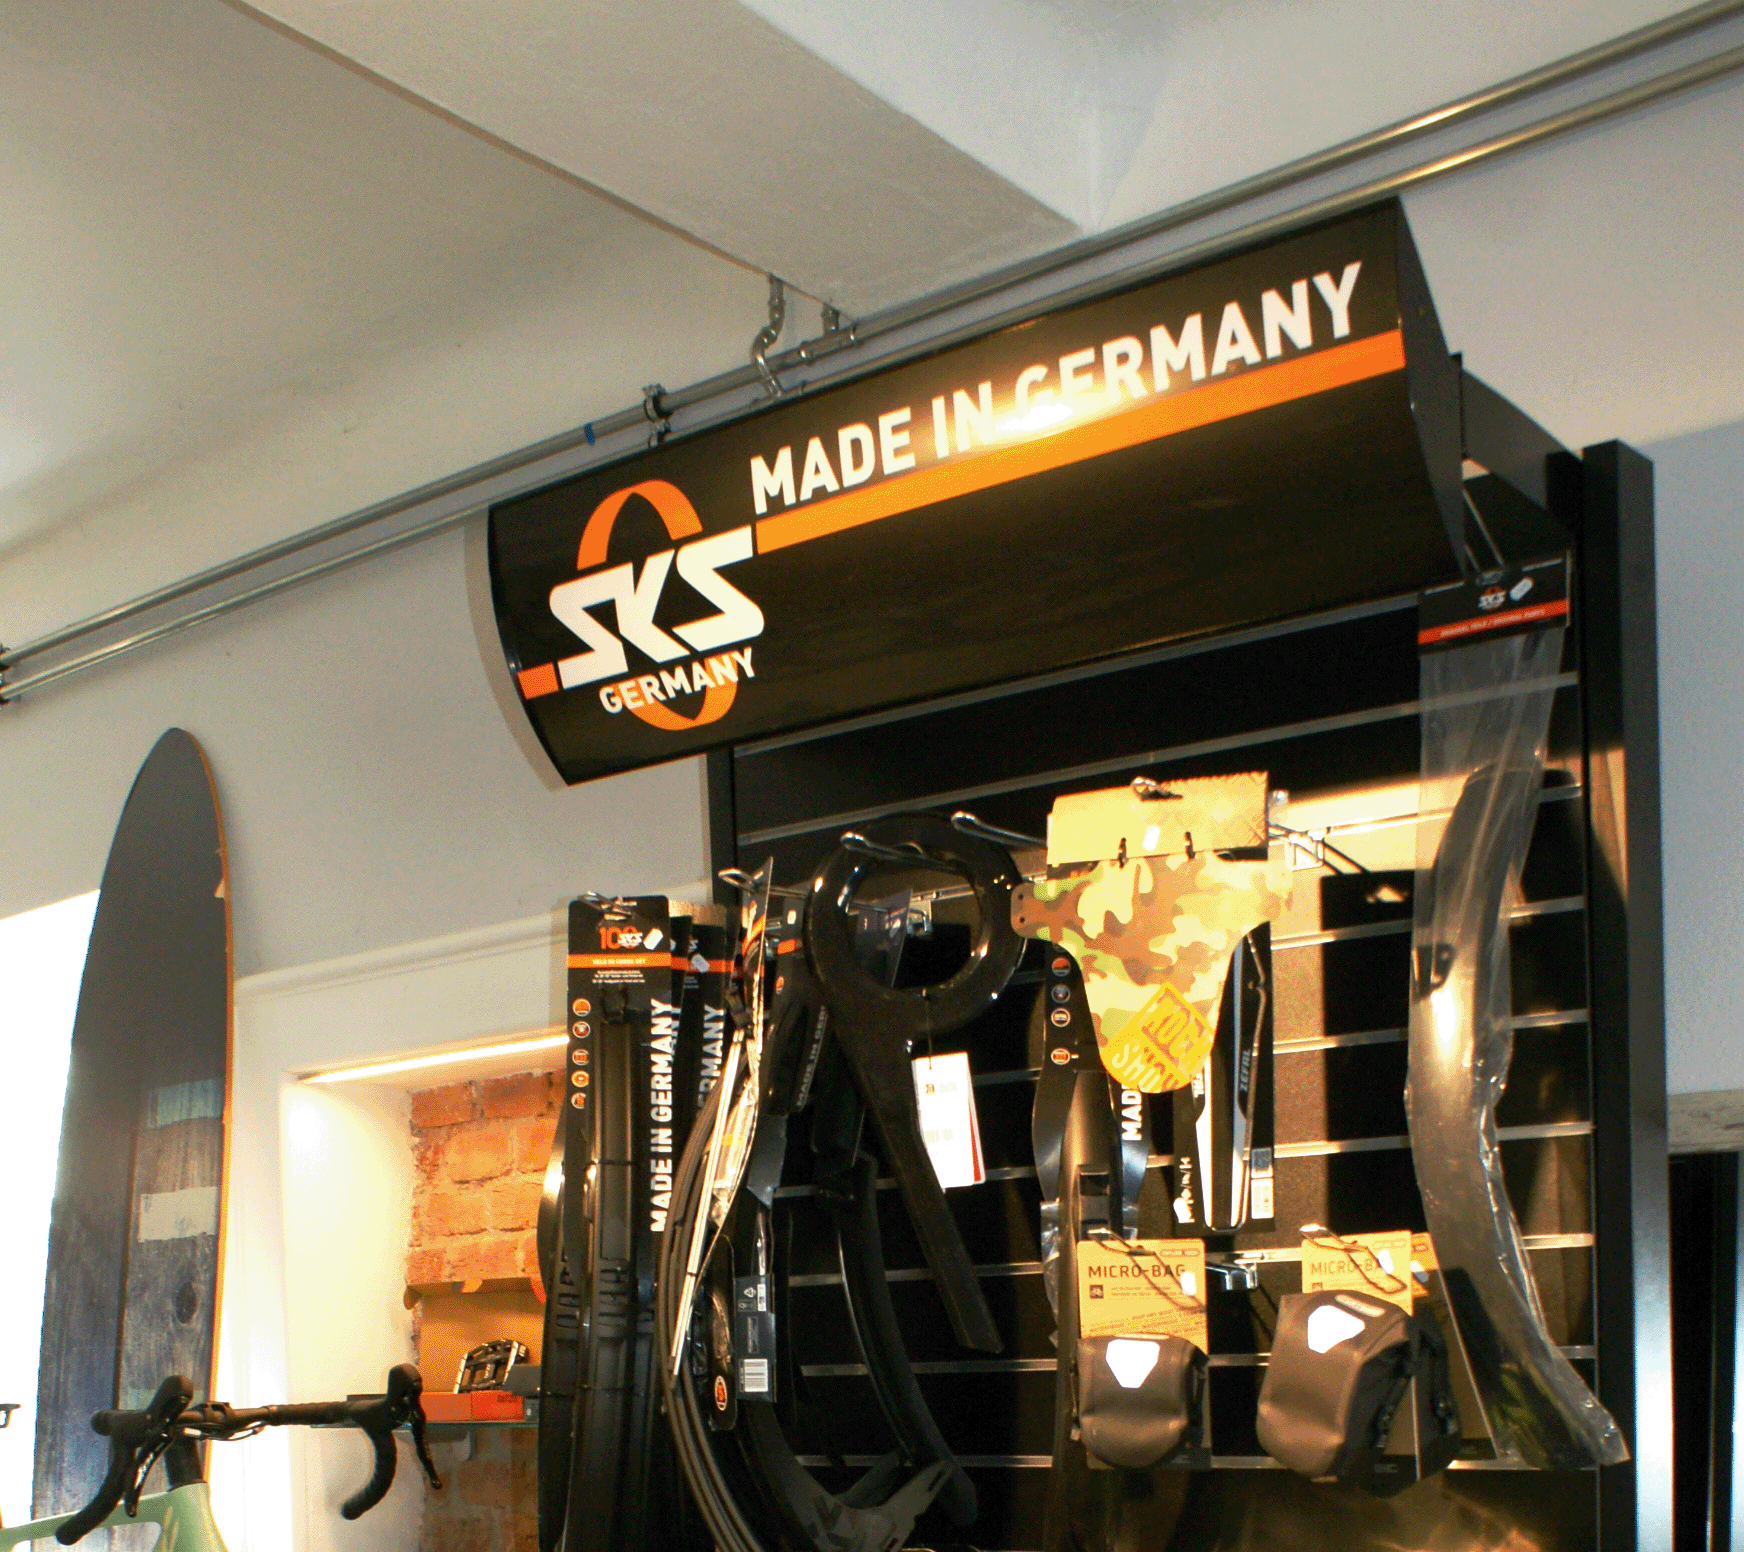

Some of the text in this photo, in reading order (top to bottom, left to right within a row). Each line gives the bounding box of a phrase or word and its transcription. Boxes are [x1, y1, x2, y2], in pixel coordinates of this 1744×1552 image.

[749, 260, 1364, 516] MADE IN GERMANY
[548, 523, 766, 692] SKS
[598, 646, 758, 717] GERMANY
[651, 998, 673, 1233] MADE IN GERMANY
[1121, 1083, 1143, 1141] MAD
[1088, 1263, 1186, 1279] MICRO-BAG
[1310, 1257, 1384, 1276] MICRO-B
